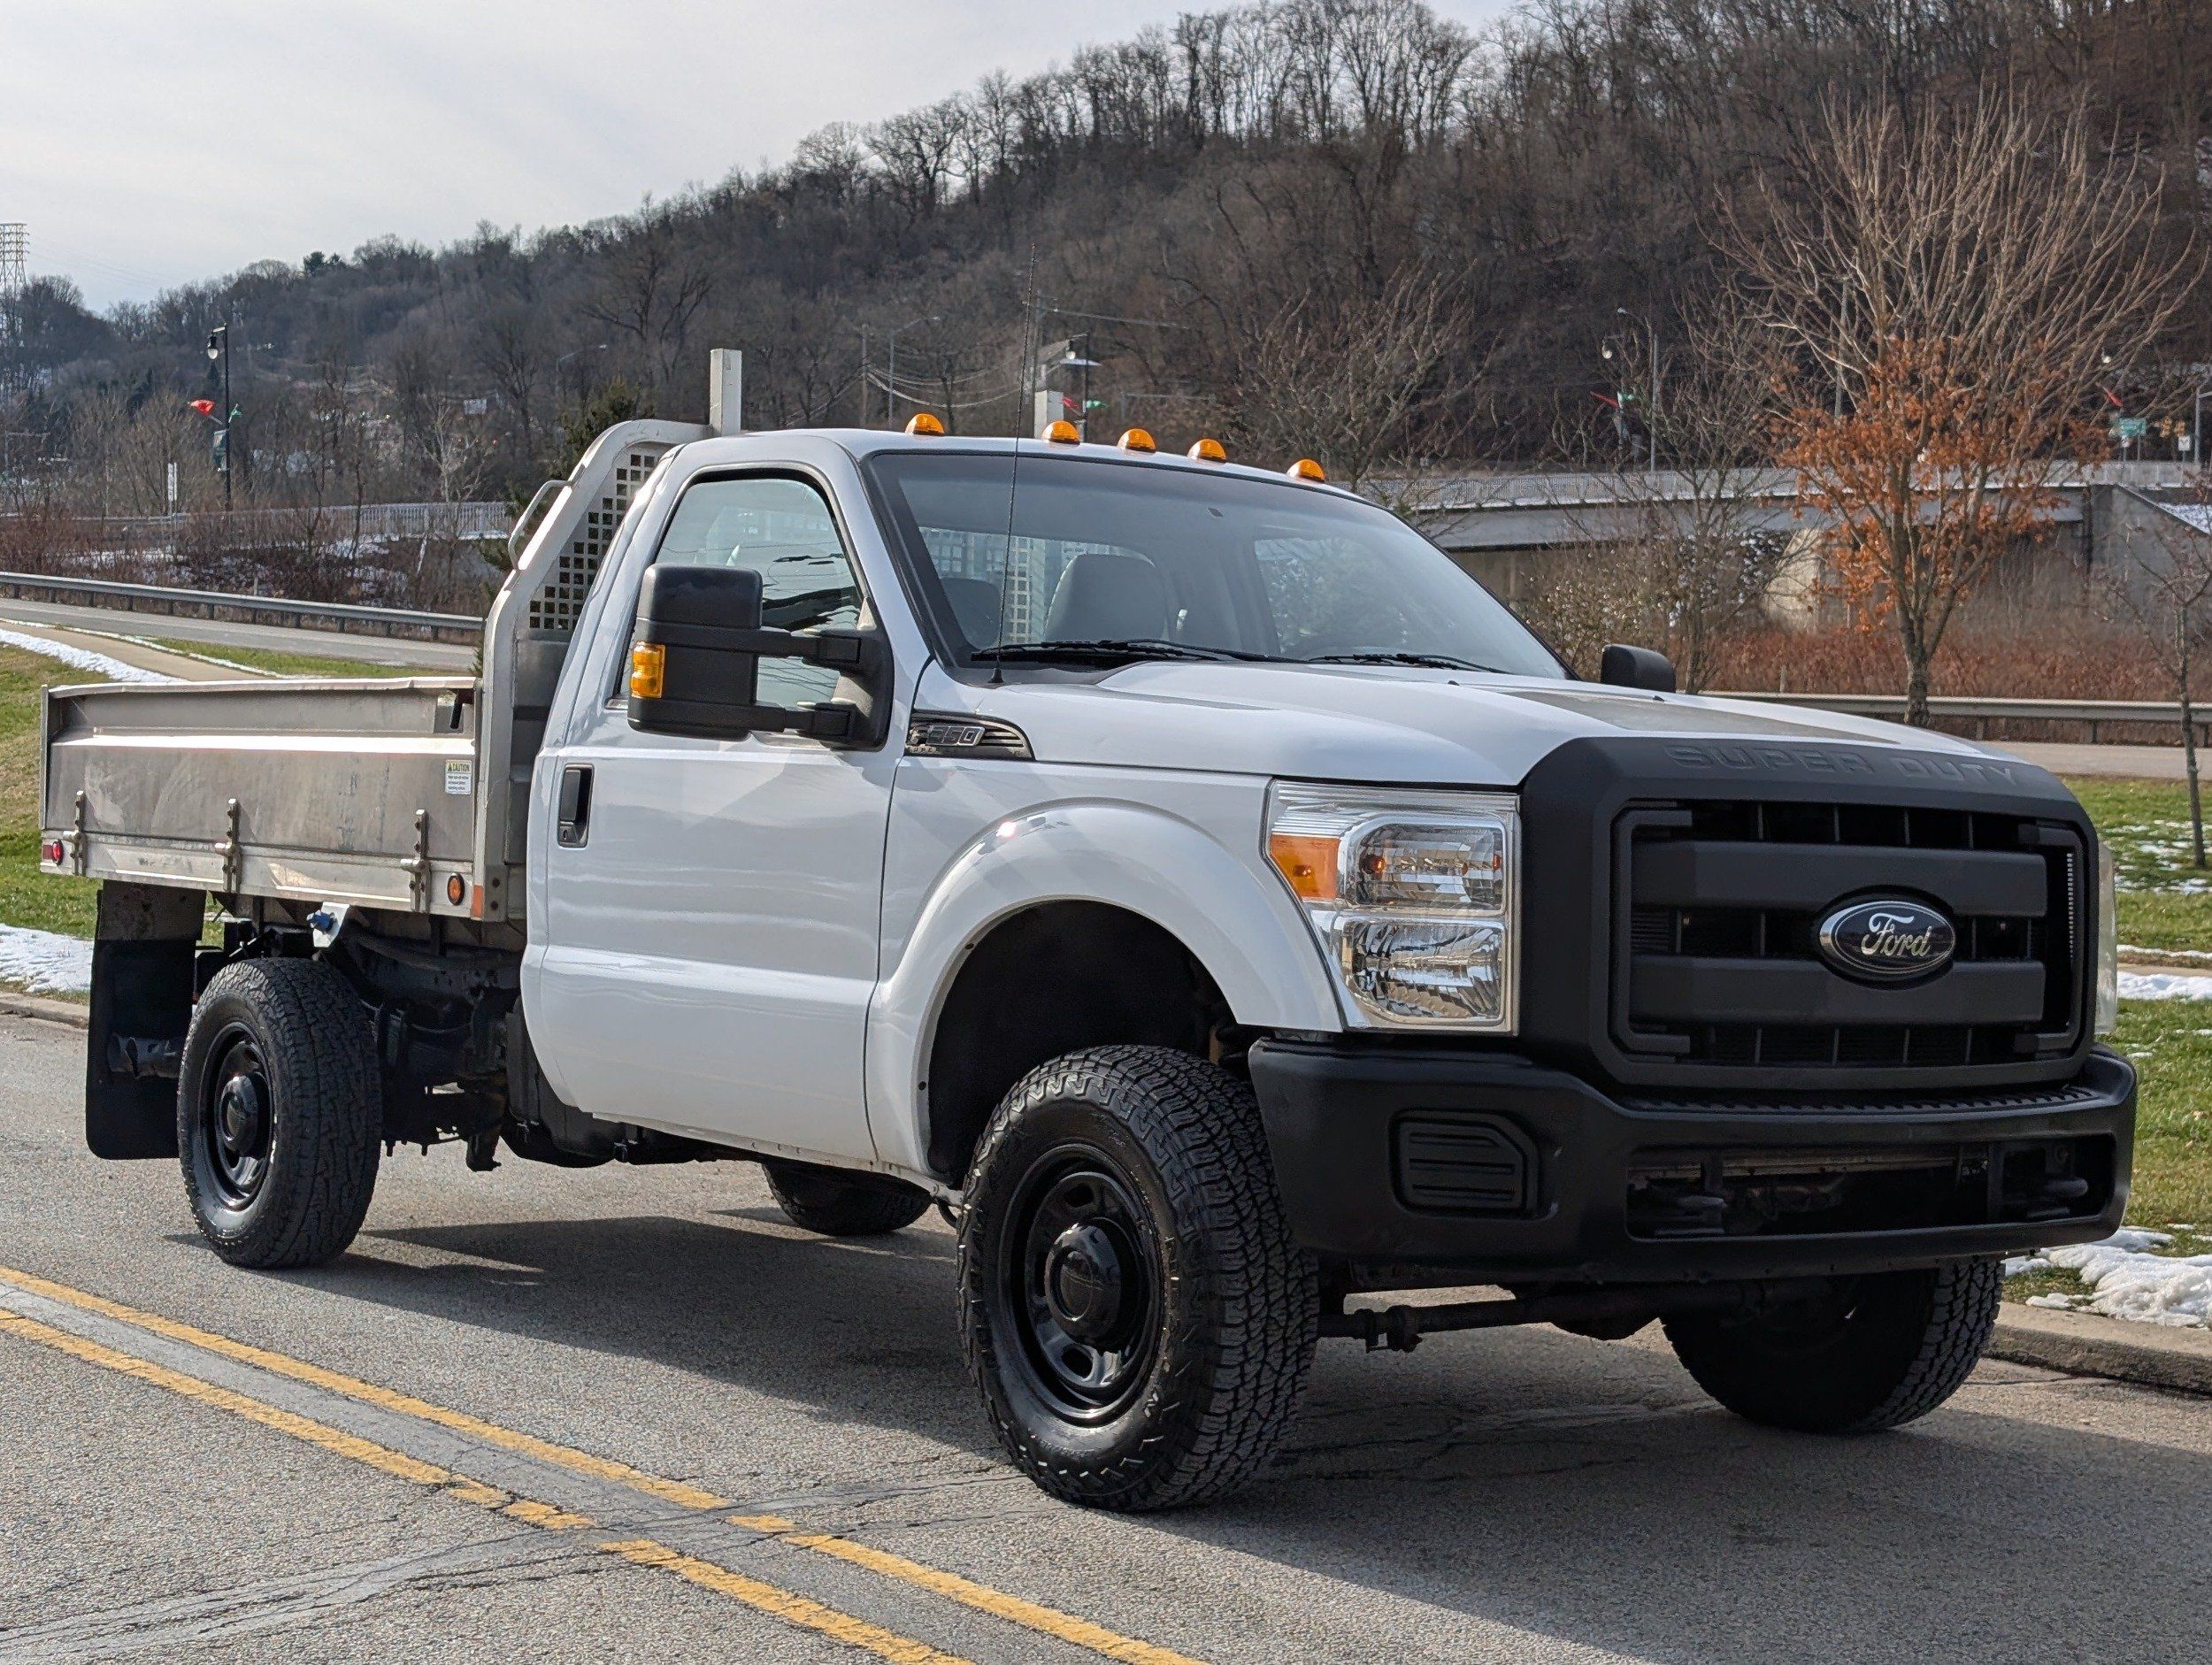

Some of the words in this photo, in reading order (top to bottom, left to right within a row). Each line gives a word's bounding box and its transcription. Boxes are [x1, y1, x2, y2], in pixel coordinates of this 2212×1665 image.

[452, 763, 470, 771] CAUTION
[1664, 744, 1876, 774] SUPER
[1889, 756, 2018, 786] DUTY
[1861, 912, 1932, 956] Ford
